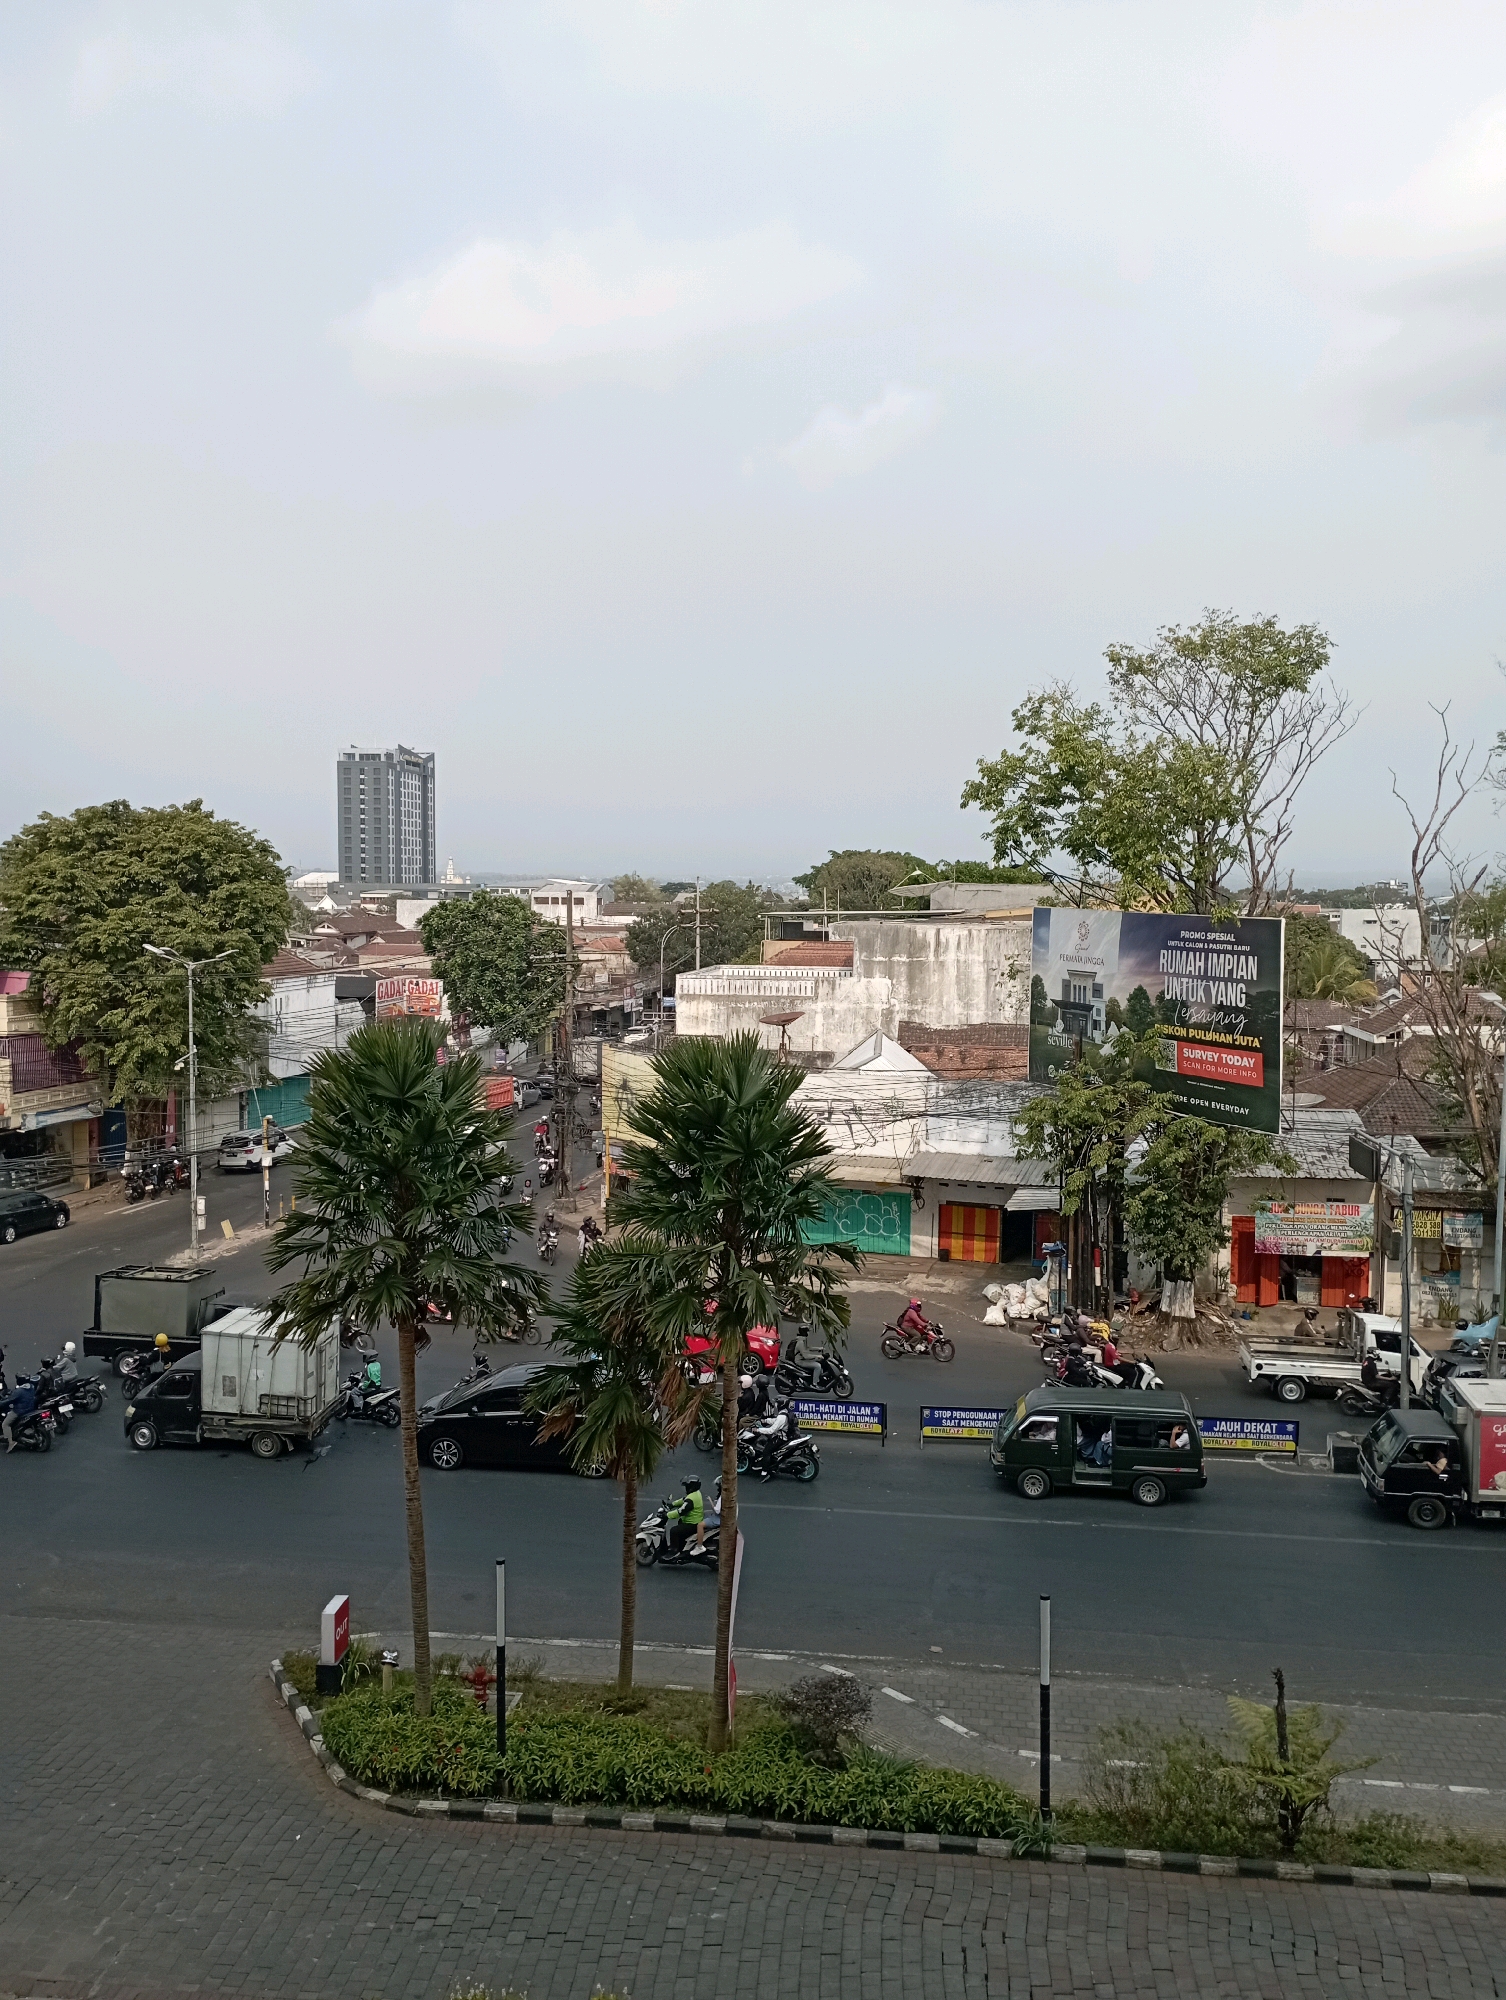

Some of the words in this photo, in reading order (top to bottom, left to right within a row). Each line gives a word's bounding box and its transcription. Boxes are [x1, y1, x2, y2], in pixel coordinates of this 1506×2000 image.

[1180, 930, 1206, 940] PROMO
[1207, 932, 1236, 941] SPESIAL
[1185, 941, 1204, 949] CALON
[1160, 949, 1205, 976] RUMAH
[1207, 952, 1258, 980] IMPIAN
[407, 979, 439, 996] GADAI
[1164, 975, 1206, 1003] UNTUK
[1209, 980, 1247, 1008] YANG
[1047, 1034, 1073, 1049] seville
[1188, 1028, 1233, 1044] PULUHAN
[1183, 1048, 1219, 1062] SURVEY
[1221, 1053, 1256, 1068] TODAY
[1183, 1060, 1201, 1070] SCAN
[1202, 1063, 1216, 1072] FOR
[1217, 1066, 1237, 1075] MORE
[1239, 1069, 1257, 1078] INFO
[1190, 1098, 1209, 1107] OPEN
[1211, 1101, 1250, 1115] EVERYDAY
[1295, 1203, 1326, 1215] BUNGA
[1429, 1285, 1453, 1293] ENDANG
[799, 1402, 836, 1413] HATI-HATI
[837, 1404, 846, 1414] DI
[847, 1405, 871, 1415] JALAN
[934, 1410, 951, 1418] STOP
[952, 1411, 997, 1420] PENGGUNAAN
[822, 1413, 849, 1422] MENANTI
[942, 1419, 959, 1427] SAAT
[960, 1420, 998, 1428] MENGEMUD
[1213, 1420, 1241, 1432] JAUH
[1243, 1422, 1278, 1433] DEKAT
[335, 1616, 348, 1640] OUT
